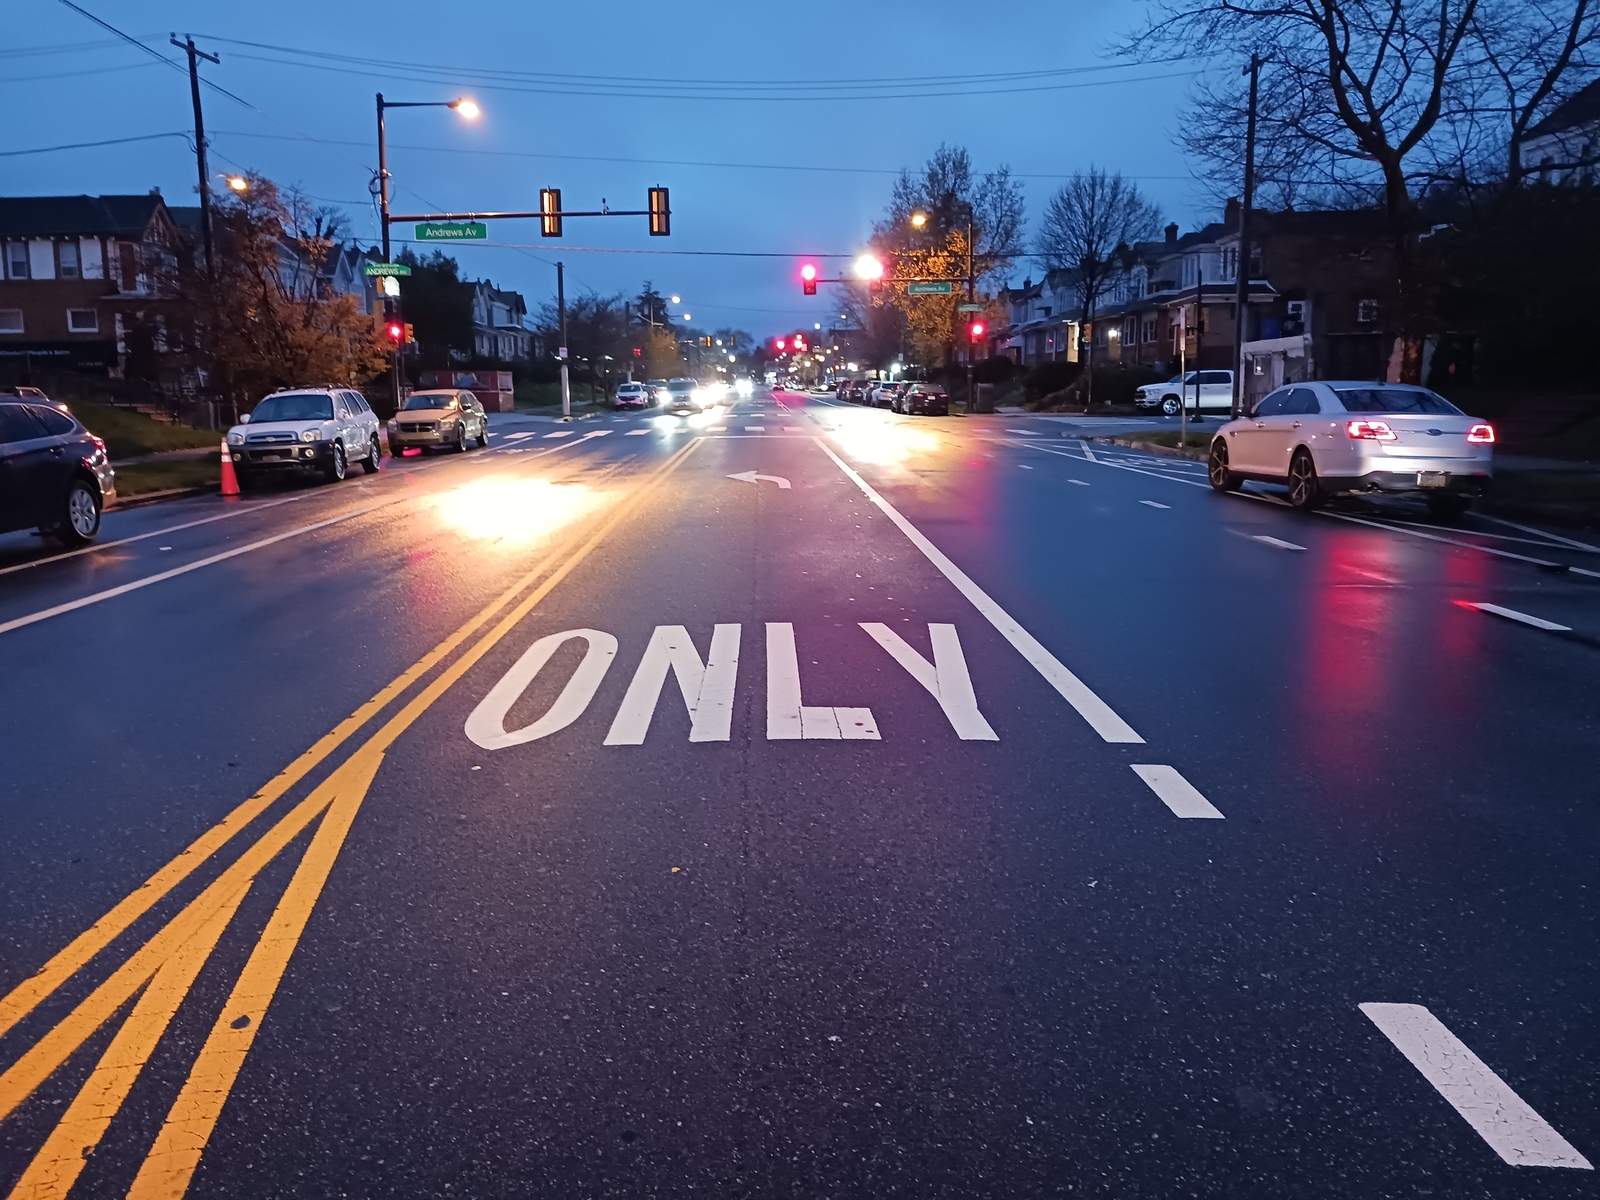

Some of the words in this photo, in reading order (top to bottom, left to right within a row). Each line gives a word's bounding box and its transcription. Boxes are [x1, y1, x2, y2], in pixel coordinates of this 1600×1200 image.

[425, 227, 464, 237] Andrews
[464, 226, 477, 236] Av
[366, 268, 399, 276] ANDREWS
[464, 622, 1000, 751] ONLY
